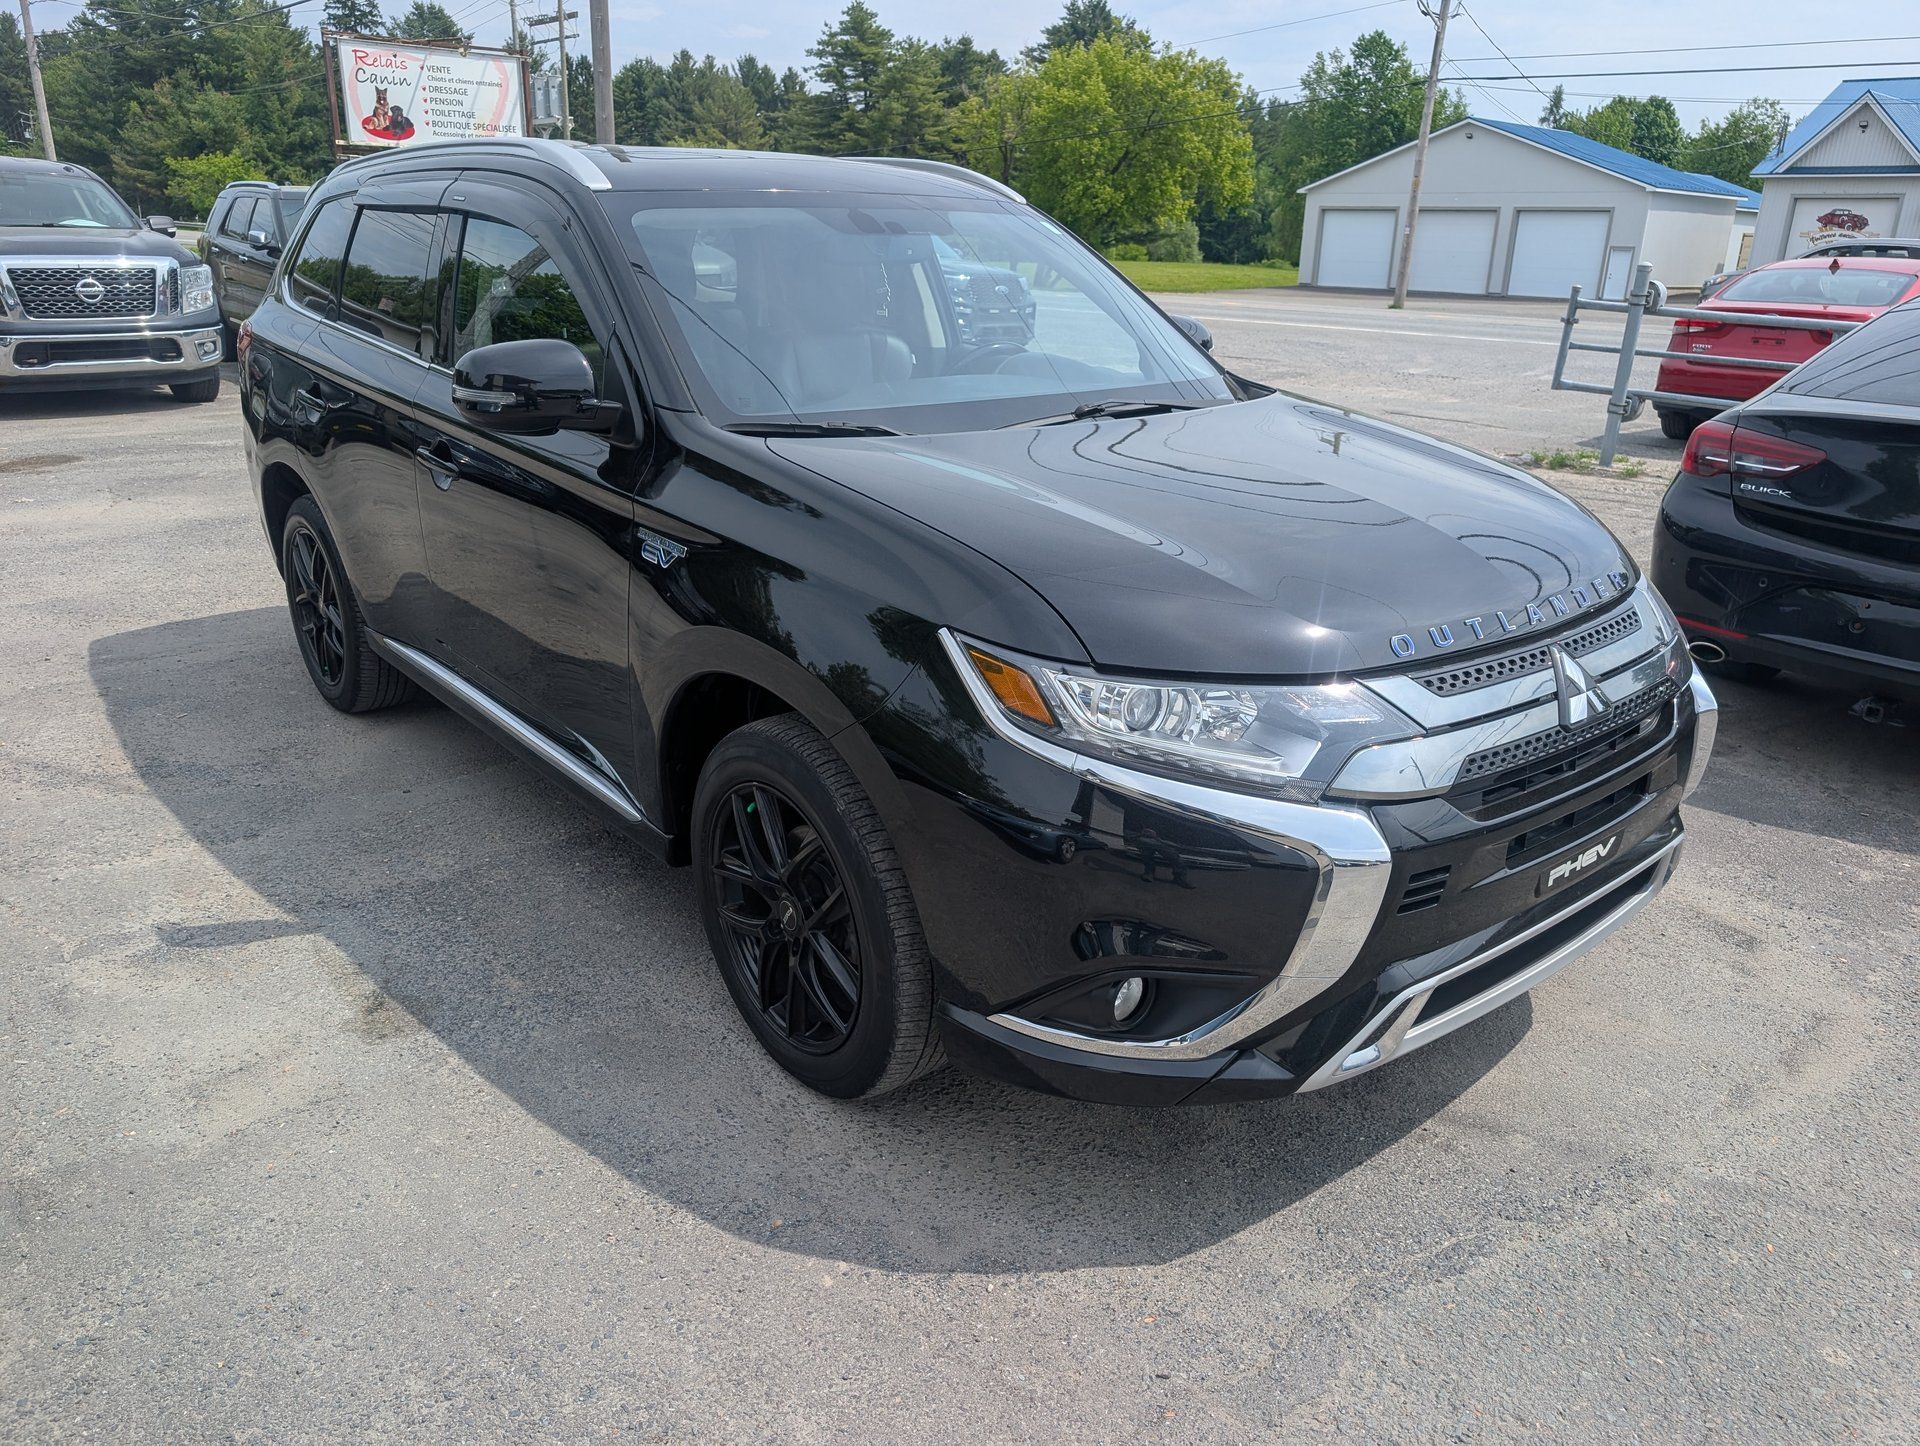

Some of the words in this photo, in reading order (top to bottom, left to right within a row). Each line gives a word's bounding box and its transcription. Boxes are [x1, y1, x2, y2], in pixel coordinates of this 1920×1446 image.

[352, 49, 408, 70] Relais
[426, 65, 451, 75] VENTE
[355, 67, 411, 87] Canin
[427, 74, 447, 83] Chiots
[455, 78, 475, 86] chiens
[428, 85, 468, 96] DRESSAGE
[429, 97, 464, 107] PENSION
[430, 108, 476, 119] TOILETTAGE
[431, 120, 472, 131] BOUTIQUE
[432, 130, 467, 139] Accessoires
[1739, 483, 1792, 498] BUICK
[1390, 570, 1628, 658] OUTLANDER
[1547, 835, 1617, 887] PHEV
